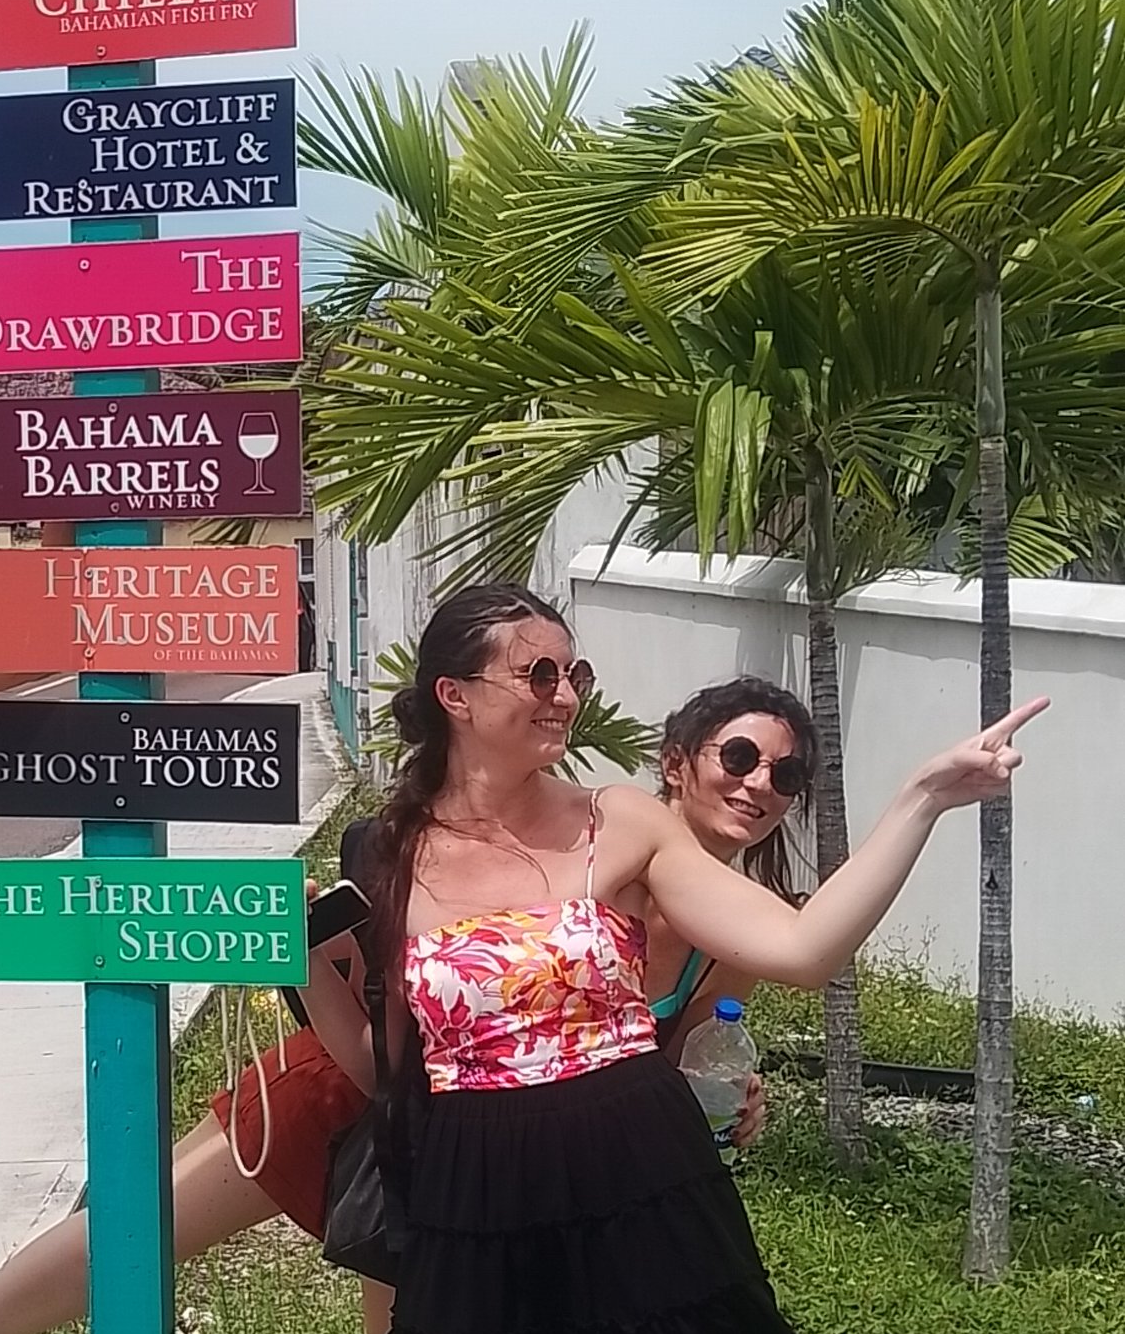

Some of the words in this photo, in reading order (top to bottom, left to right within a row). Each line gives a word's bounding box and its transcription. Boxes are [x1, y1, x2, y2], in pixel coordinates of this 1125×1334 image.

[59, 12, 166, 33] BAHAMIAN
[171, 6, 214, 25] FISH
[220, 1, 258, 20] FRY
[62, 93, 277, 134] GRAYCLIFF
[90, 135, 226, 173] HOTEL
[236, 132, 270, 164] &
[24, 176, 279, 217] RESTAURANT
[181, 248, 283, 294] THE
[15, 409, 222, 452] BAHAMA
[22, 455, 220, 497] BARRELS
[125, 492, 220, 510] WINERY
[43, 557, 280, 599] HERITAGE
[71, 603, 280, 646] MUSEUM
[154, 649, 172, 661] OF
[178, 649, 205, 661] THE
[210, 648, 279, 661] BAHAMAS
[132, 727, 277, 754] BAHAMAS
[134, 755, 281, 789] TOURS
[58, 875, 290, 917] HERITAGE
[118, 920, 292, 963] SHOPPE
